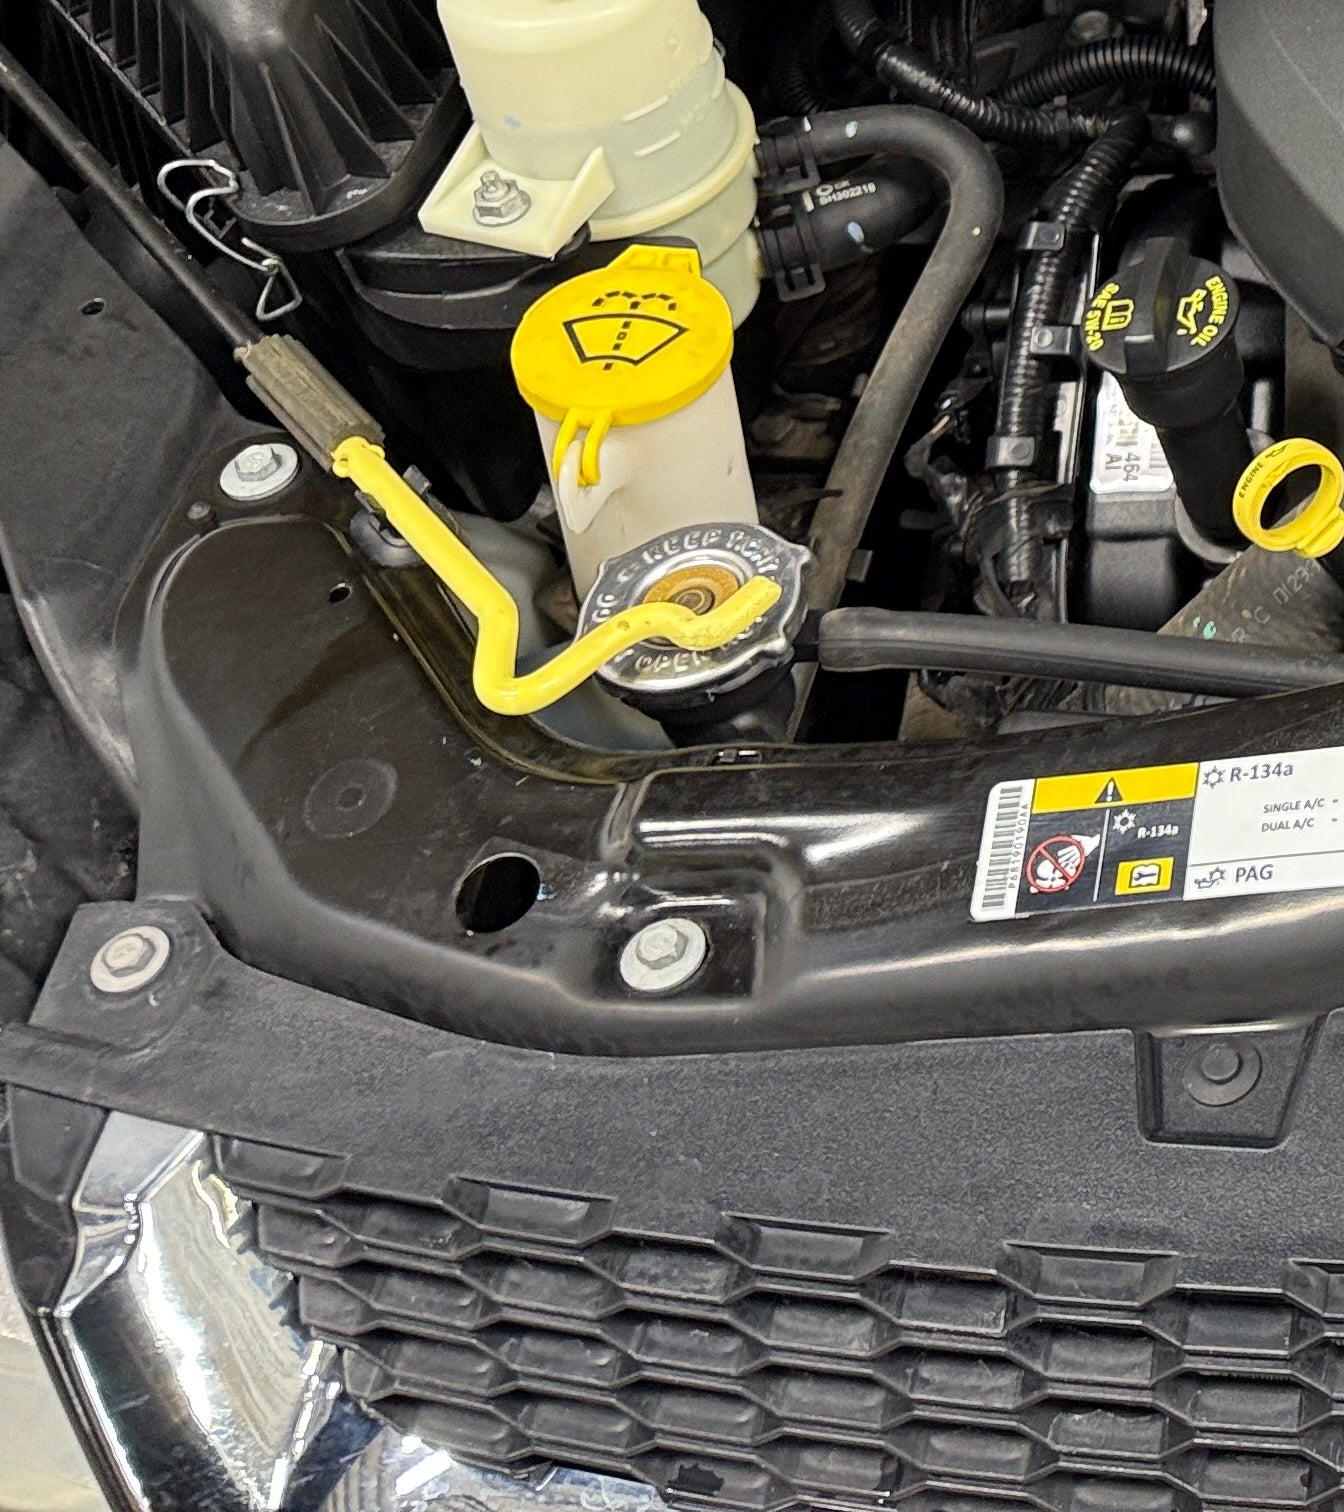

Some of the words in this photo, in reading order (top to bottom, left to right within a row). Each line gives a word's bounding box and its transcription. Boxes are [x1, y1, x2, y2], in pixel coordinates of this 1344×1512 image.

[1091, 282, 1121, 309] SAE
[1205, 275, 1230, 325] ENGINE
[1084, 309, 1105, 352] 5W-20
[1189, 324, 1220, 348] OIL
[1122, 451, 1142, 483] 464
[1238, 461, 1265, 499] ENGINE
[1229, 761, 1296, 784] R-134a
[1262, 799, 1302, 815] SINGLE
[1302, 797, 1326, 811] A/C
[1136, 823, 1181, 840] R-134a
[1261, 819, 1292, 834] DUAL
[1292, 816, 1315, 831] A/C
[1234, 863, 1275, 884] PAG
